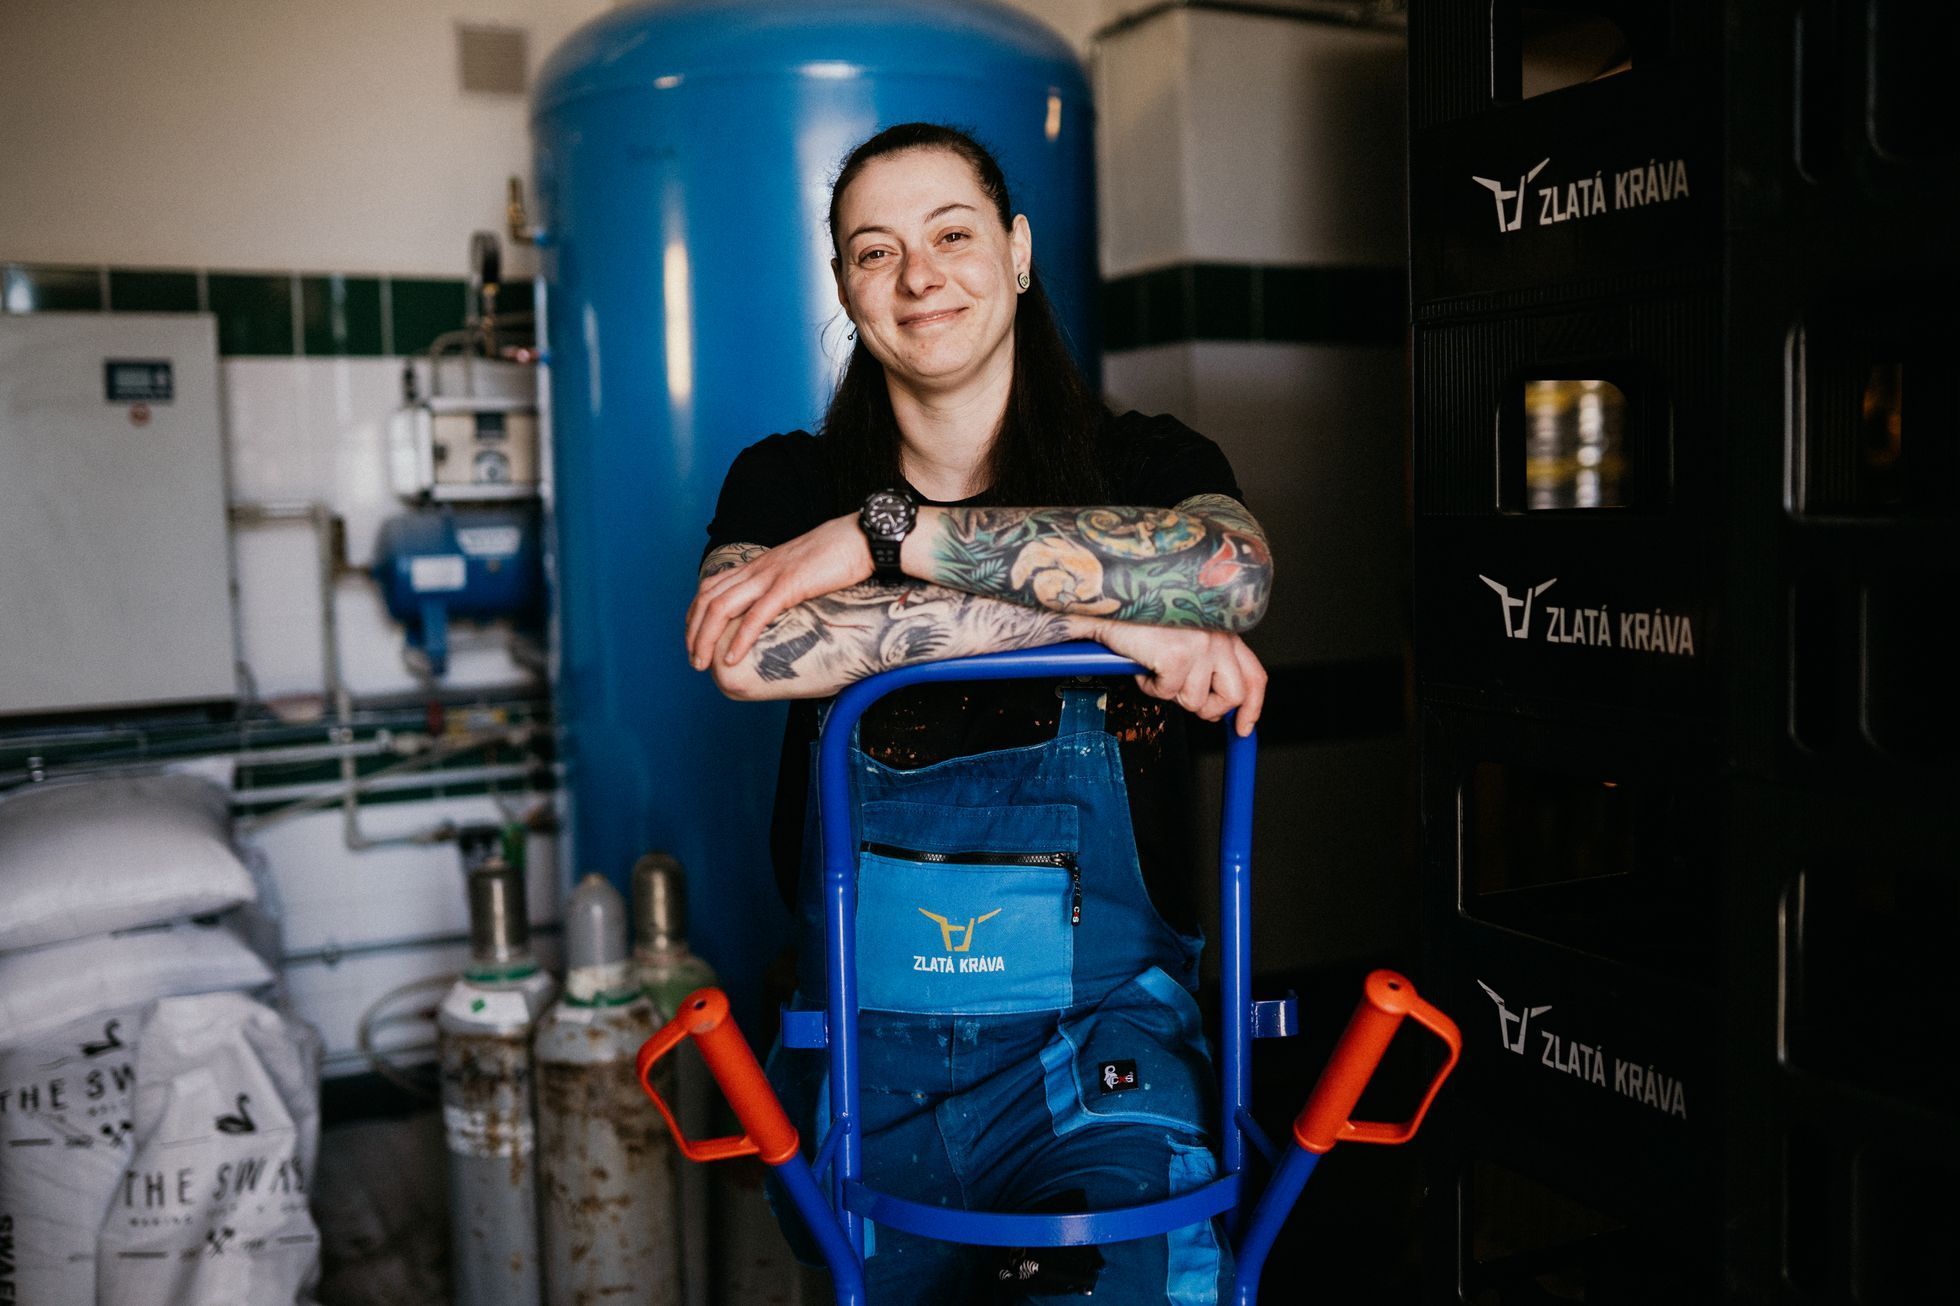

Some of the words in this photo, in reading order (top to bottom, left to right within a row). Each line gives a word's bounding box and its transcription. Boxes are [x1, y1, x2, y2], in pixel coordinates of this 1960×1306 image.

[1538, 171, 1607, 226] ZLATÁ
[1615, 158, 1689, 210] KRÁVA
[1546, 605, 1612, 648] ZLATÁ
[1620, 608, 1695, 656] KRÁVA
[913, 955, 955, 973] ZLATÁ
[959, 955, 1005, 973] KRÁVA
[1541, 1030, 1606, 1088] ZLATÁ
[1615, 1058, 1687, 1120] KRÁVA
[124, 1168, 193, 1208] THE
